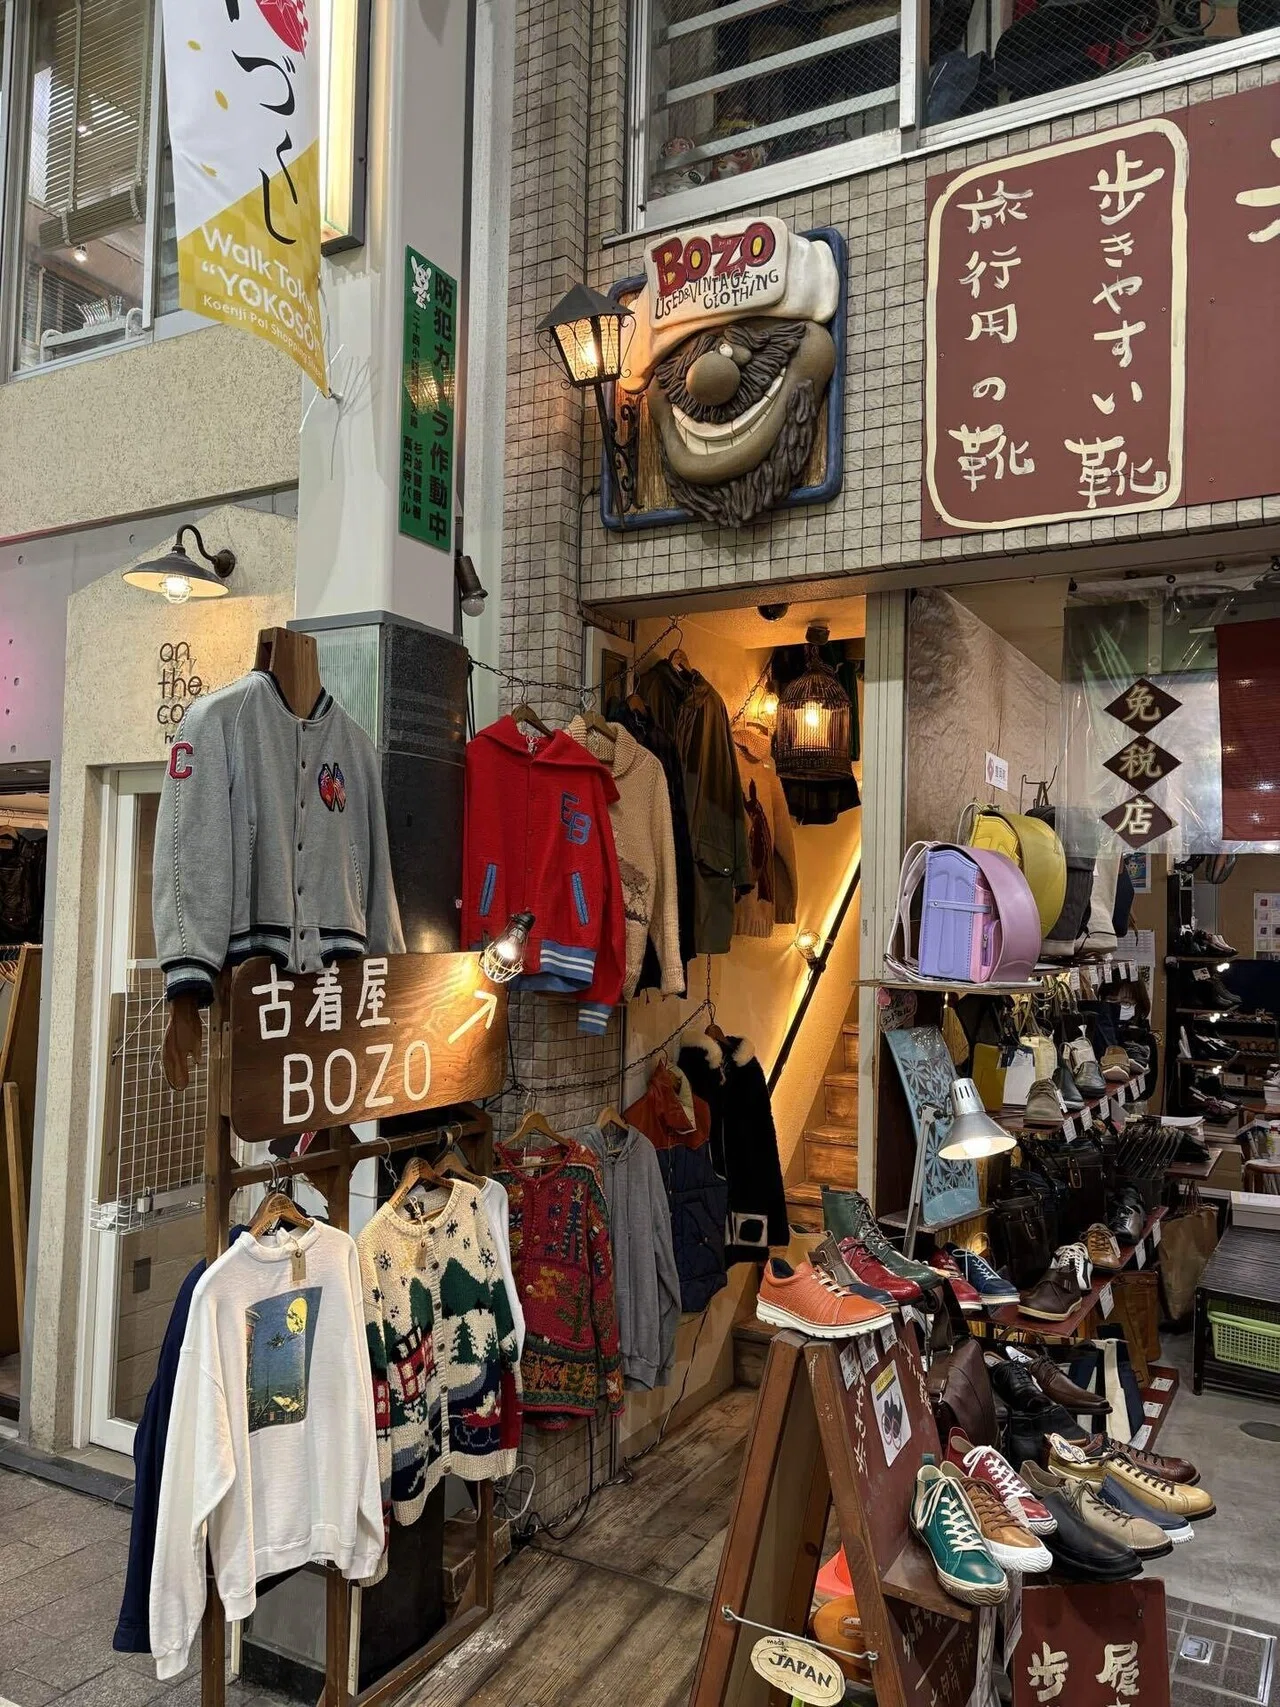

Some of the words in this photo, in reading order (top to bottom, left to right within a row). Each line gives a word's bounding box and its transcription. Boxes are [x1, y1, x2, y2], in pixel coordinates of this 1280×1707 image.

[225, 0, 298, 245] づくし
[201, 224, 273, 281] Walk
[651, 221, 777, 298] BOZO
[203, 294, 247, 321] Koenji
[249, 313, 268, 330] Pal
[703, 268, 779, 310] CLOTHING
[947, 180, 1034, 492] 旅行用の靴
[1063, 149, 1167, 508] 歩きやすい靴
[157, 667, 203, 700] the
[159, 641, 190, 663] on
[168, 742, 194, 780] C
[1117, 684, 1164, 836] 免税店
[251, 957, 391, 1040] 古着屋
[283, 1040, 432, 1125] BOZO
[768, 1651, 833, 1689] JAPAN
